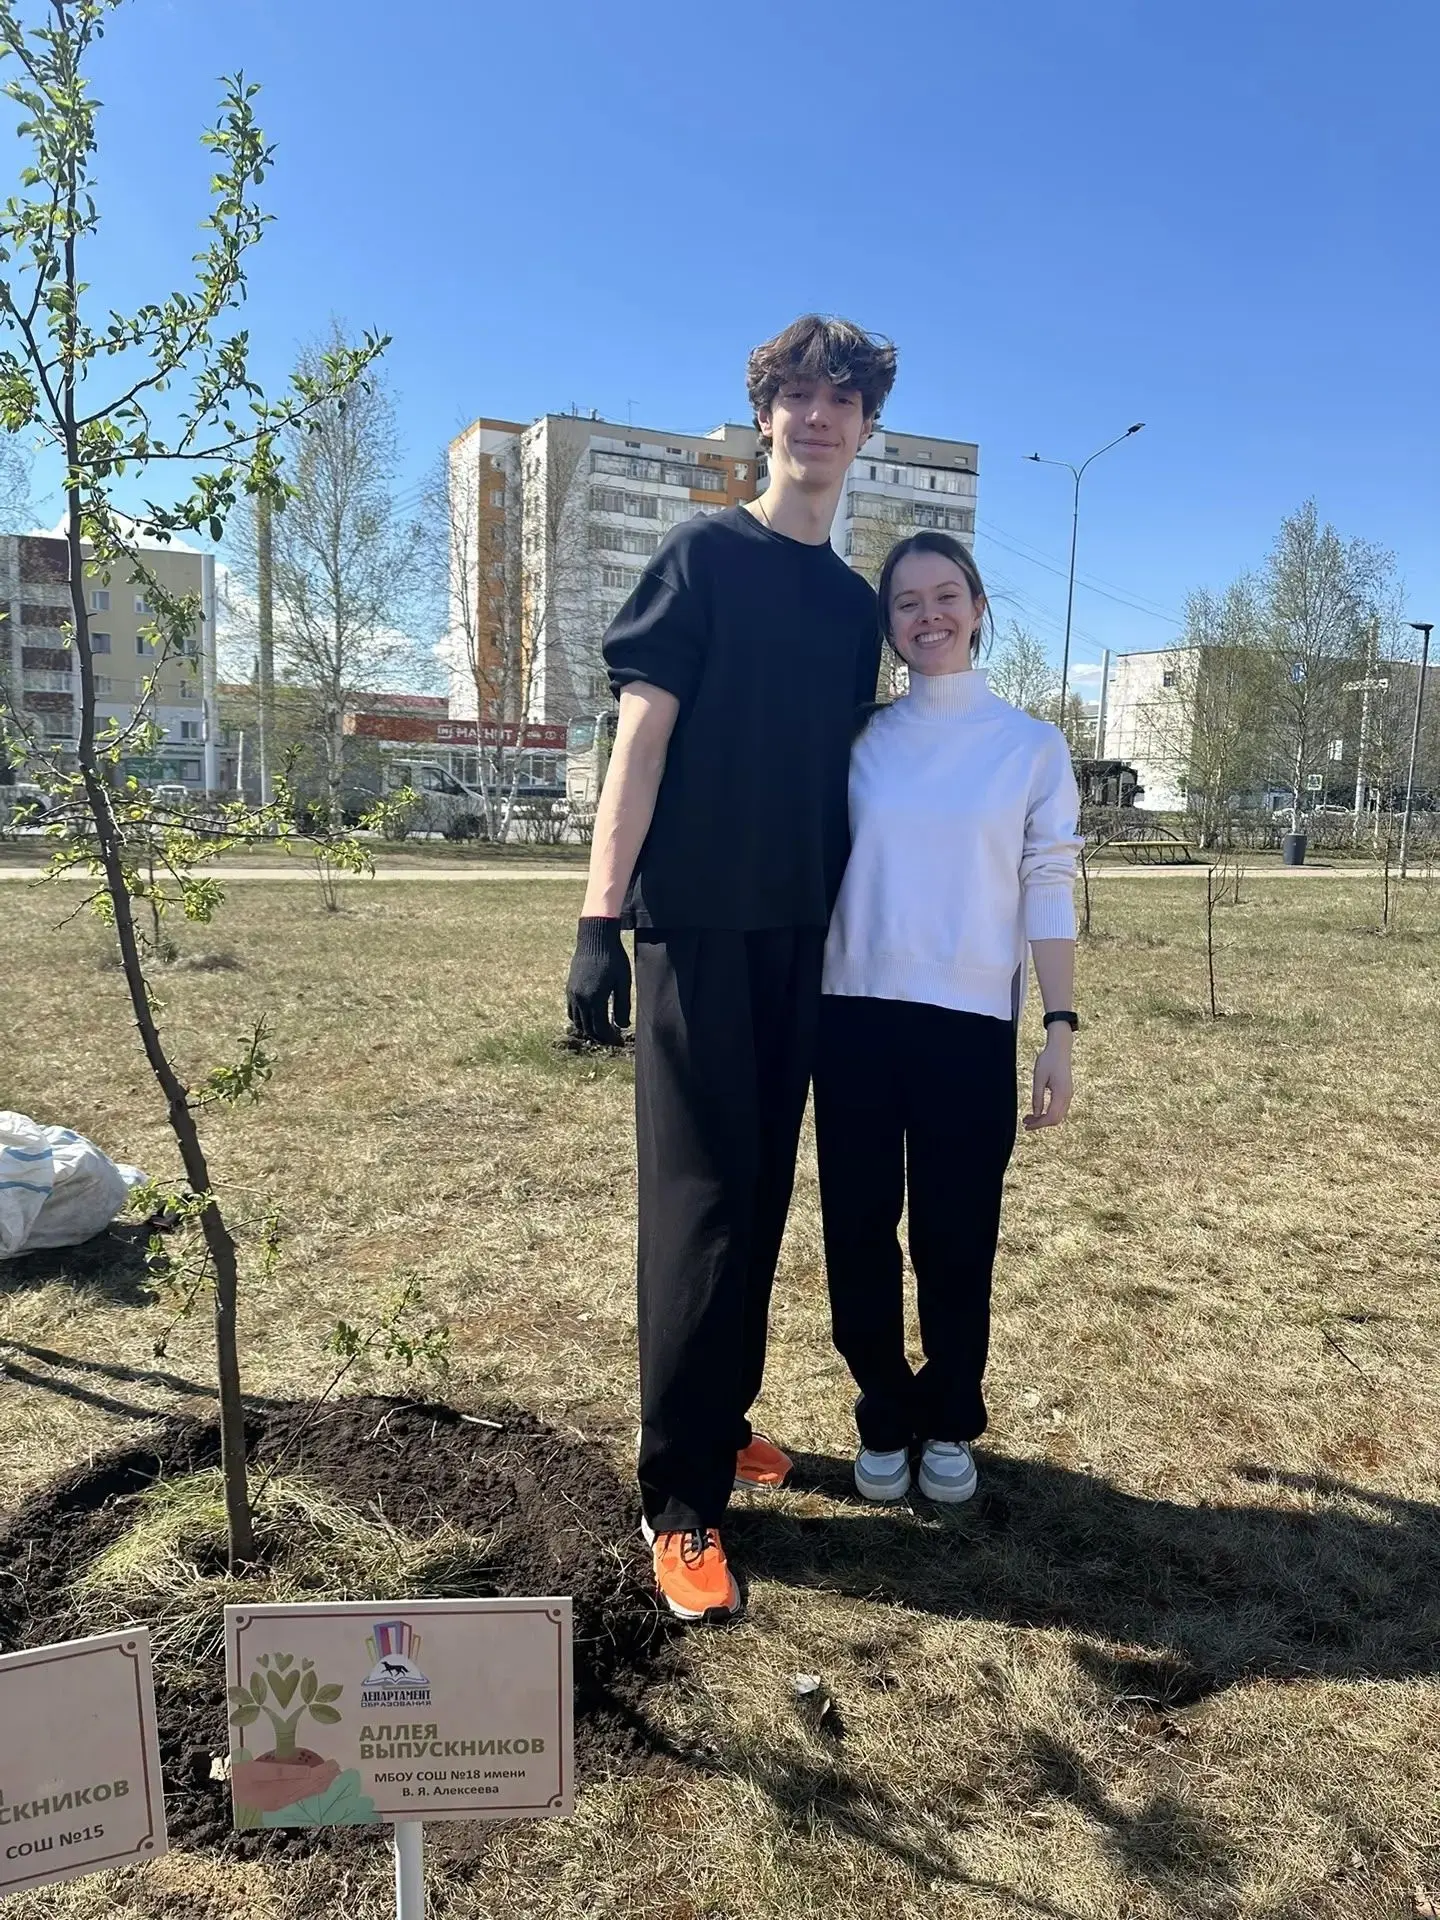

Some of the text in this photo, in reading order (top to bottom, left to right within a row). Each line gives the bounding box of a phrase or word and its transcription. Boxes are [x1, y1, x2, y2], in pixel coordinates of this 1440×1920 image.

[361, 1690, 431, 1702] ДЕПАРТАМЕНТ
[359, 1724, 438, 1741] АЛЛЕЯ
[360, 1738, 545, 1760] ВЫПУСКНИКОВ
[374, 1769, 526, 1783] МБОУ СОШ №18 имени
[402, 1785, 499, 1797] В. Я. Алексеева
[6, 1824, 105, 1860] СОШ №15
